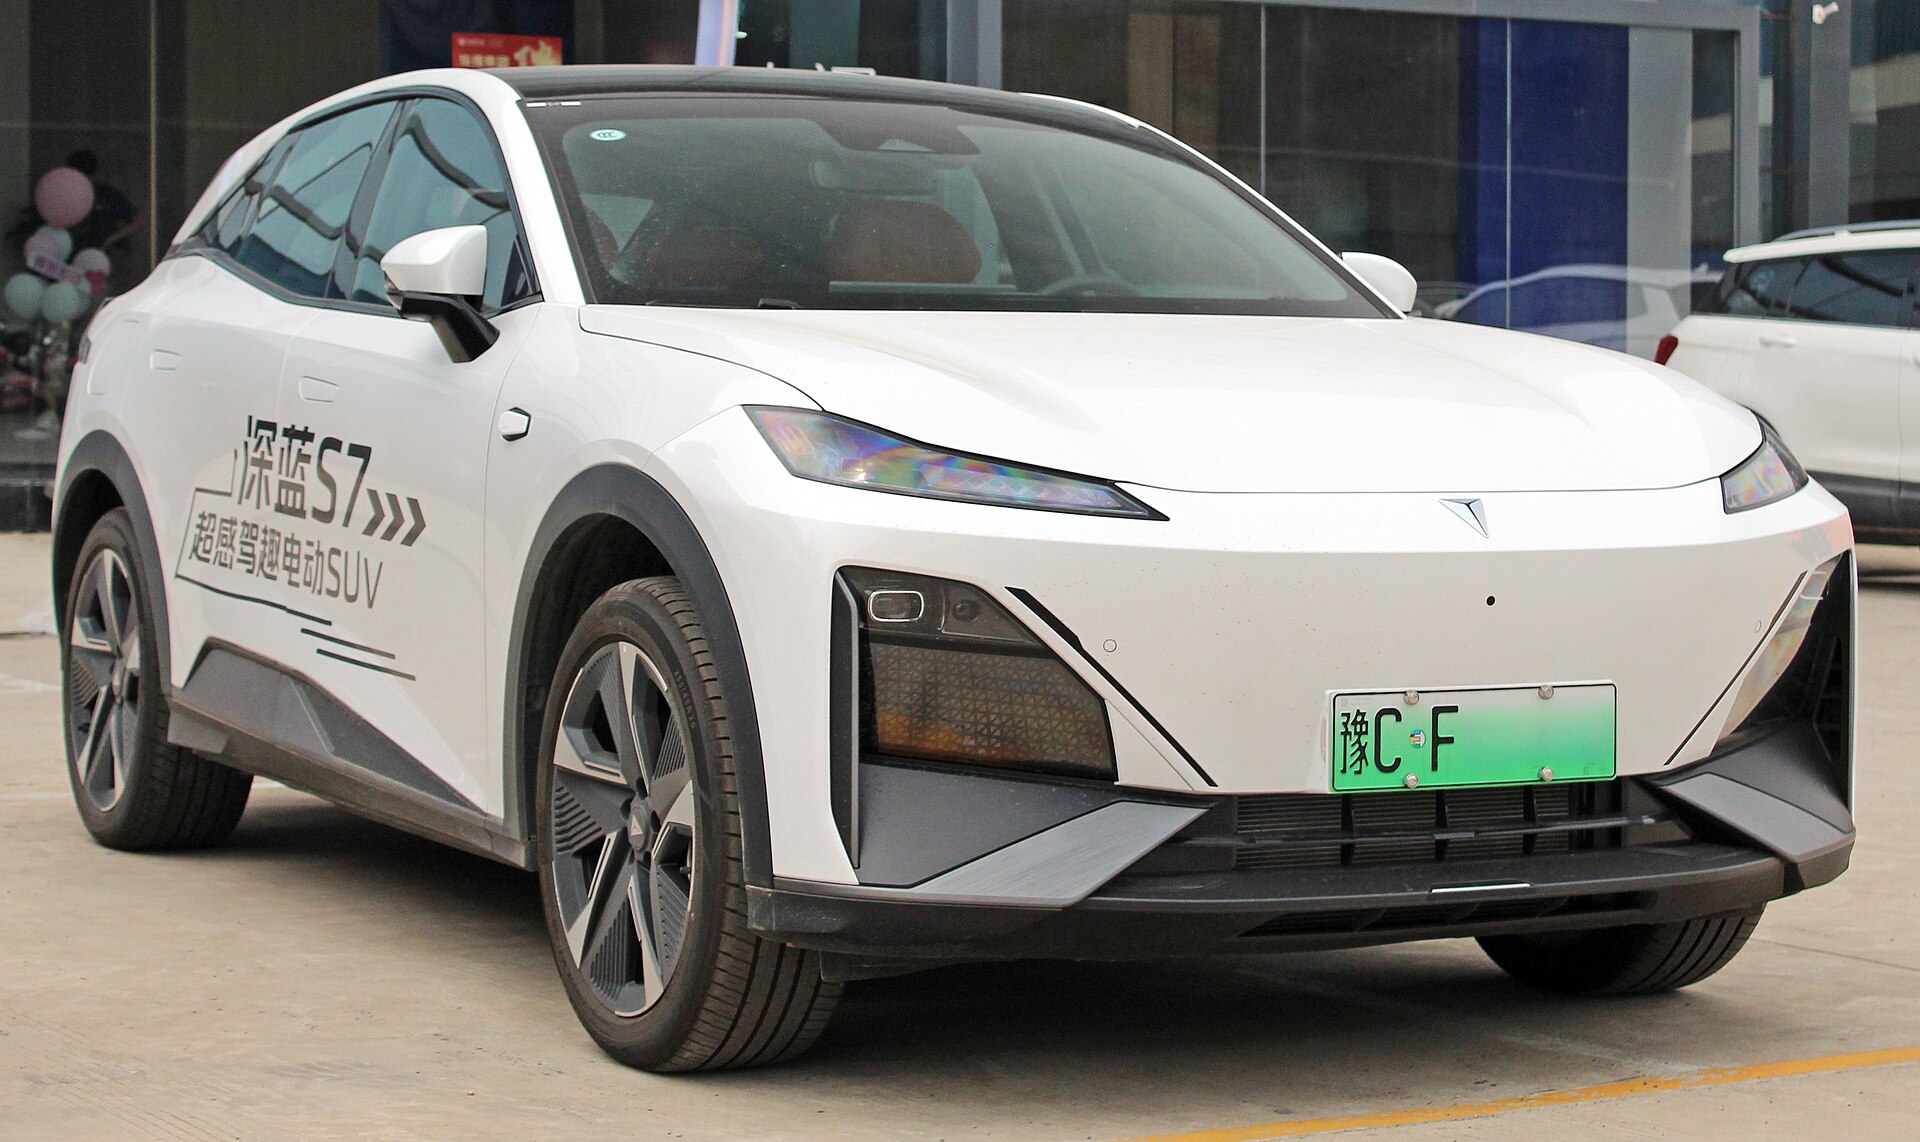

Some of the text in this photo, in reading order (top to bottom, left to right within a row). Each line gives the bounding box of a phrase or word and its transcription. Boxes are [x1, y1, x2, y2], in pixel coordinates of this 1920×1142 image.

[237, 414, 372, 528] 深蓝S7
[189, 510, 383, 610] 超感驾趣电动SUV
